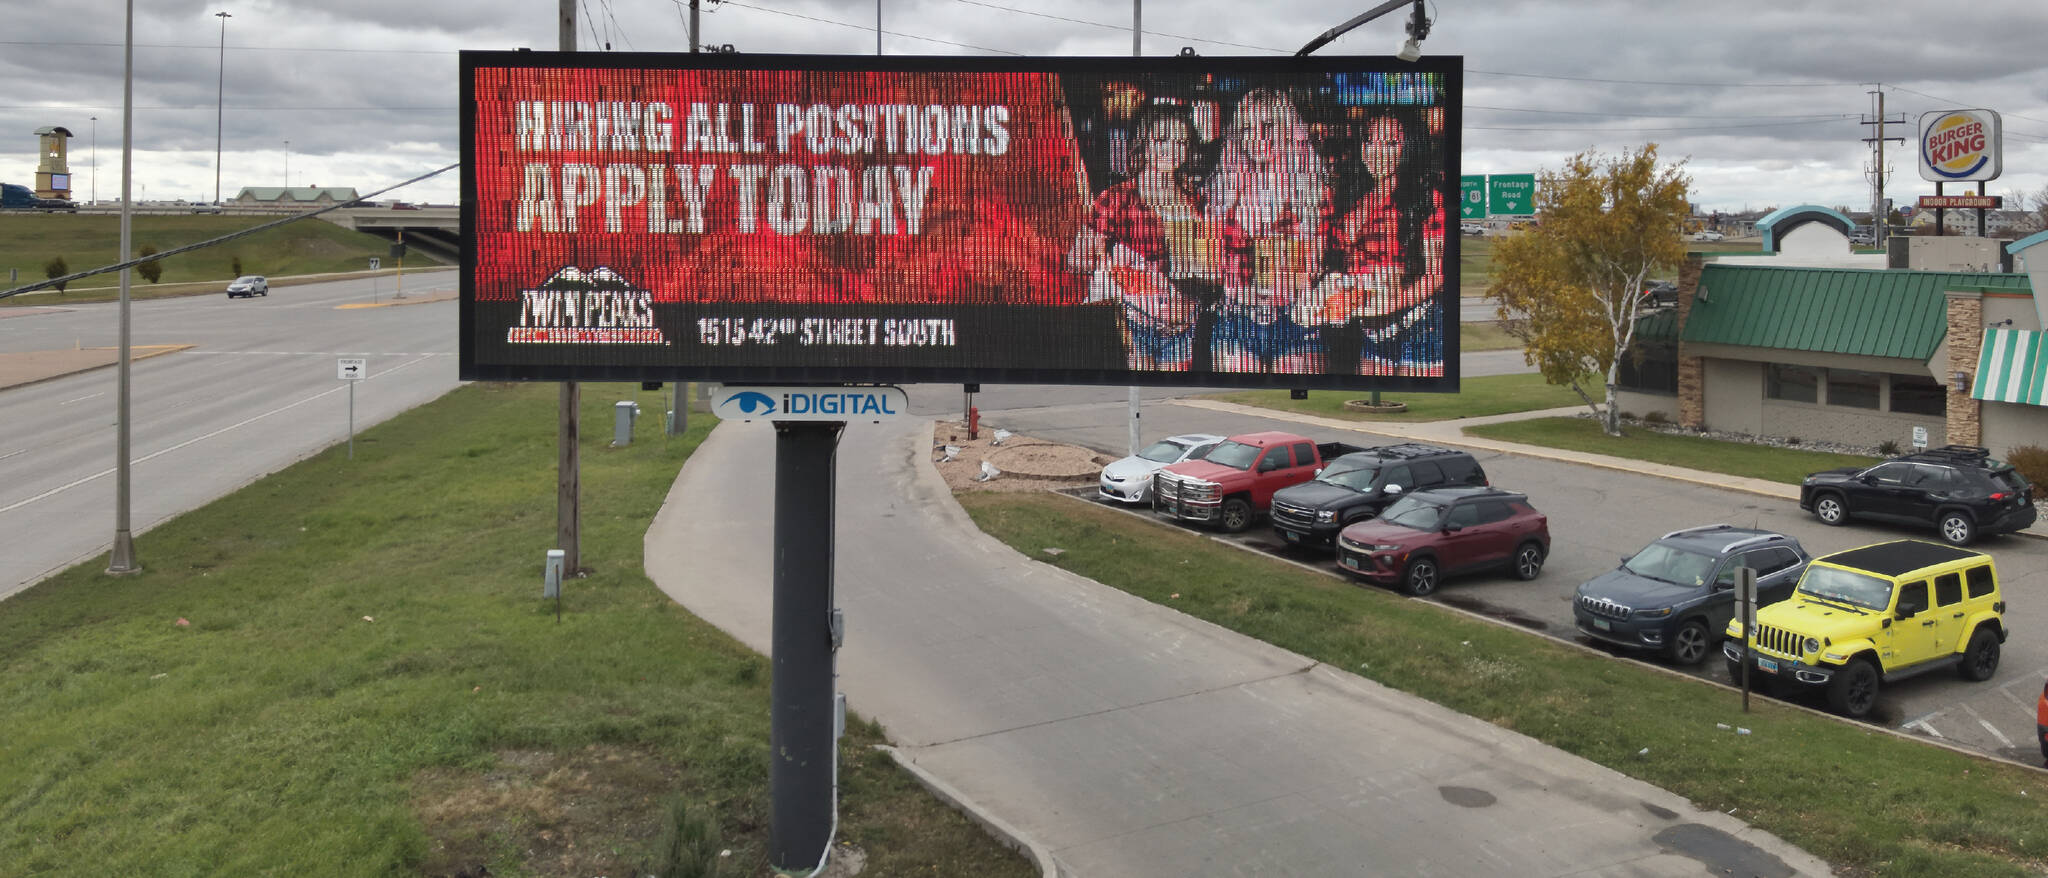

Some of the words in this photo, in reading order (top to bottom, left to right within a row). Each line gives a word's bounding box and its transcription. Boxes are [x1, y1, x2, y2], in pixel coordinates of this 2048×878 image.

[515, 101, 673, 152] HIRING
[683, 102, 766, 153] ALL
[776, 104, 1010, 156] POSITIONS
[1929, 122, 1983, 149] BURGER
[1931, 134, 1985, 166] KING
[517, 163, 718, 234] APPLY
[728, 164, 935, 235] TODAY
[1493, 181, 1529, 189] Frontage
[1923, 197, 1947, 206] INDOOR
[1949, 197, 1991, 207] PLAYGROUND
[520, 290, 581, 327] TWIN
[584, 290, 653, 327] PEAKS
[697, 317, 746, 346] 1515
[800, 318, 879, 345] STREET
[884, 318, 956, 346] SOUTH
[783, 393, 896, 415] iDIGITAL
